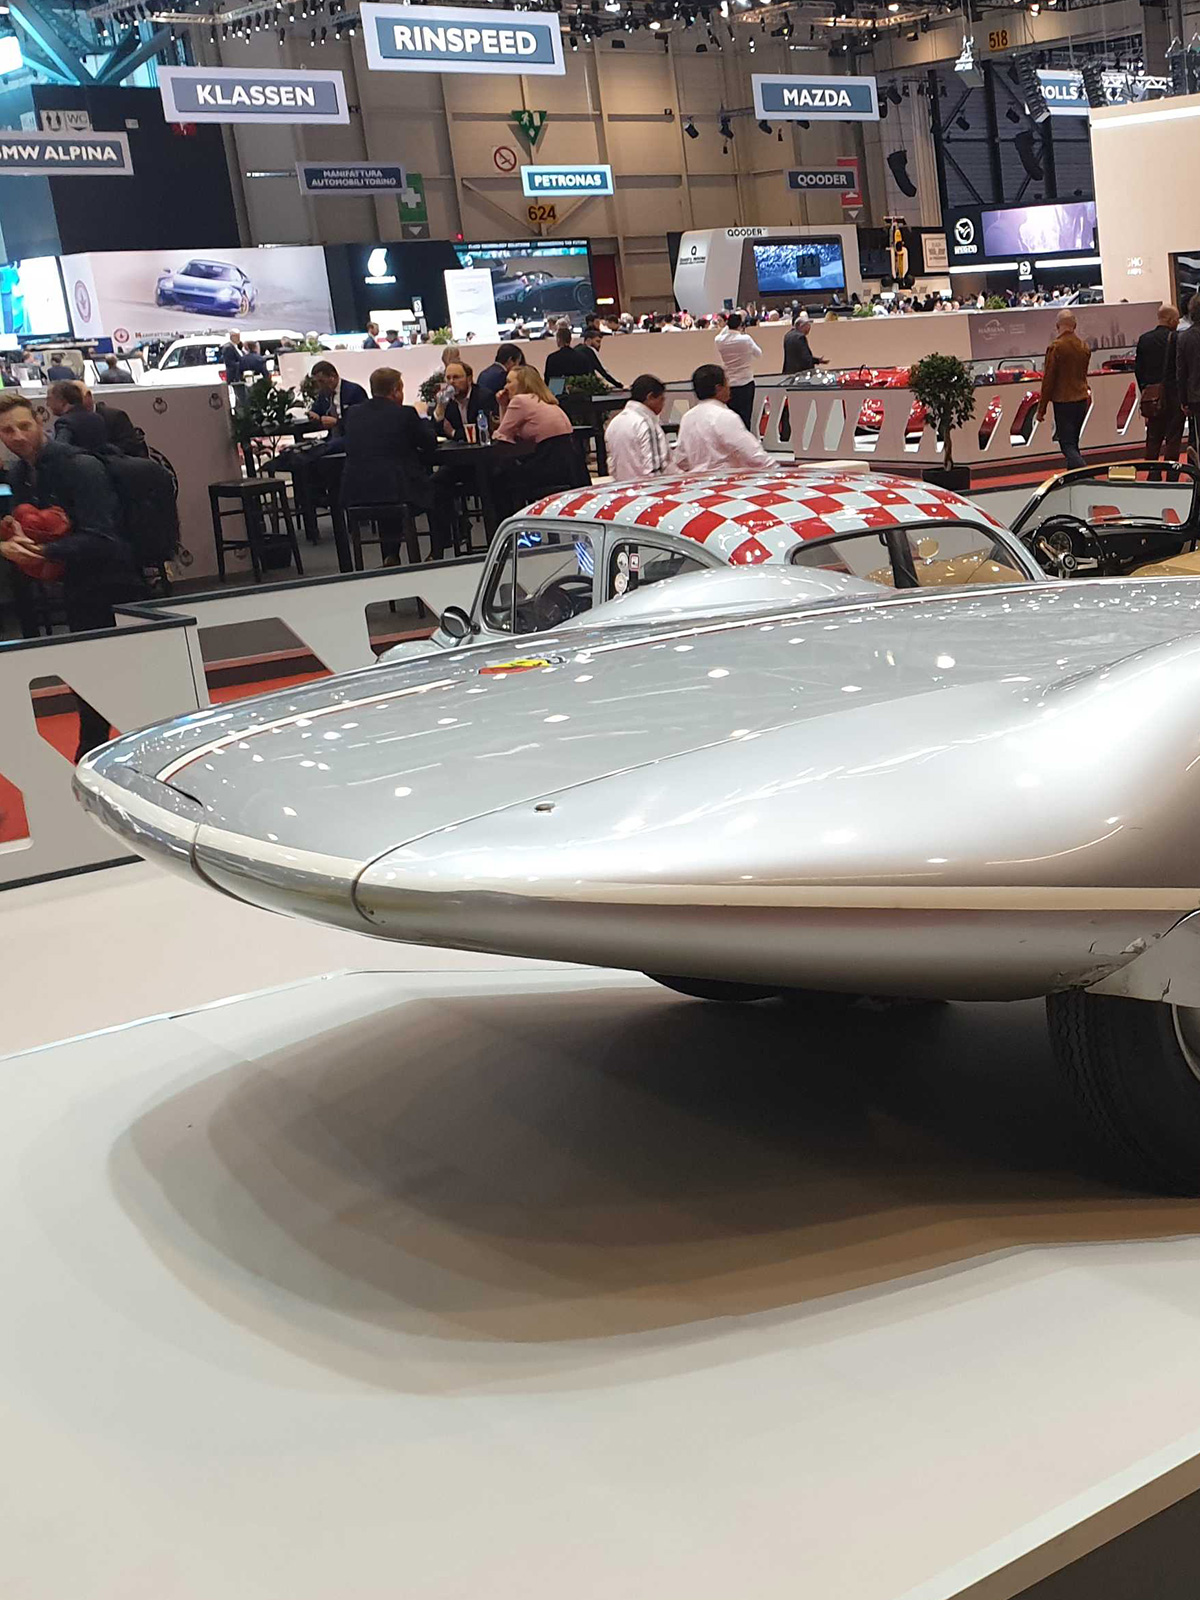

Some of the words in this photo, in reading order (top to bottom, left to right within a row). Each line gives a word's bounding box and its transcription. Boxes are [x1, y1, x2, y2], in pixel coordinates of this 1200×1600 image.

[393, 25, 538, 56] RINSPEED
[989, 29, 1008, 48] 518
[196, 84, 316, 107] KLASSEN
[783, 88, 852, 107] MAZDA
[67, 114, 87, 124] WC
[0, 145, 40, 160] MW
[44, 145, 118, 161] ALPINA
[534, 174, 602, 187] PETRONAS
[797, 174, 848, 187] QOODER
[528, 205, 556, 221] 624
[727, 228, 764, 237] QOODER
